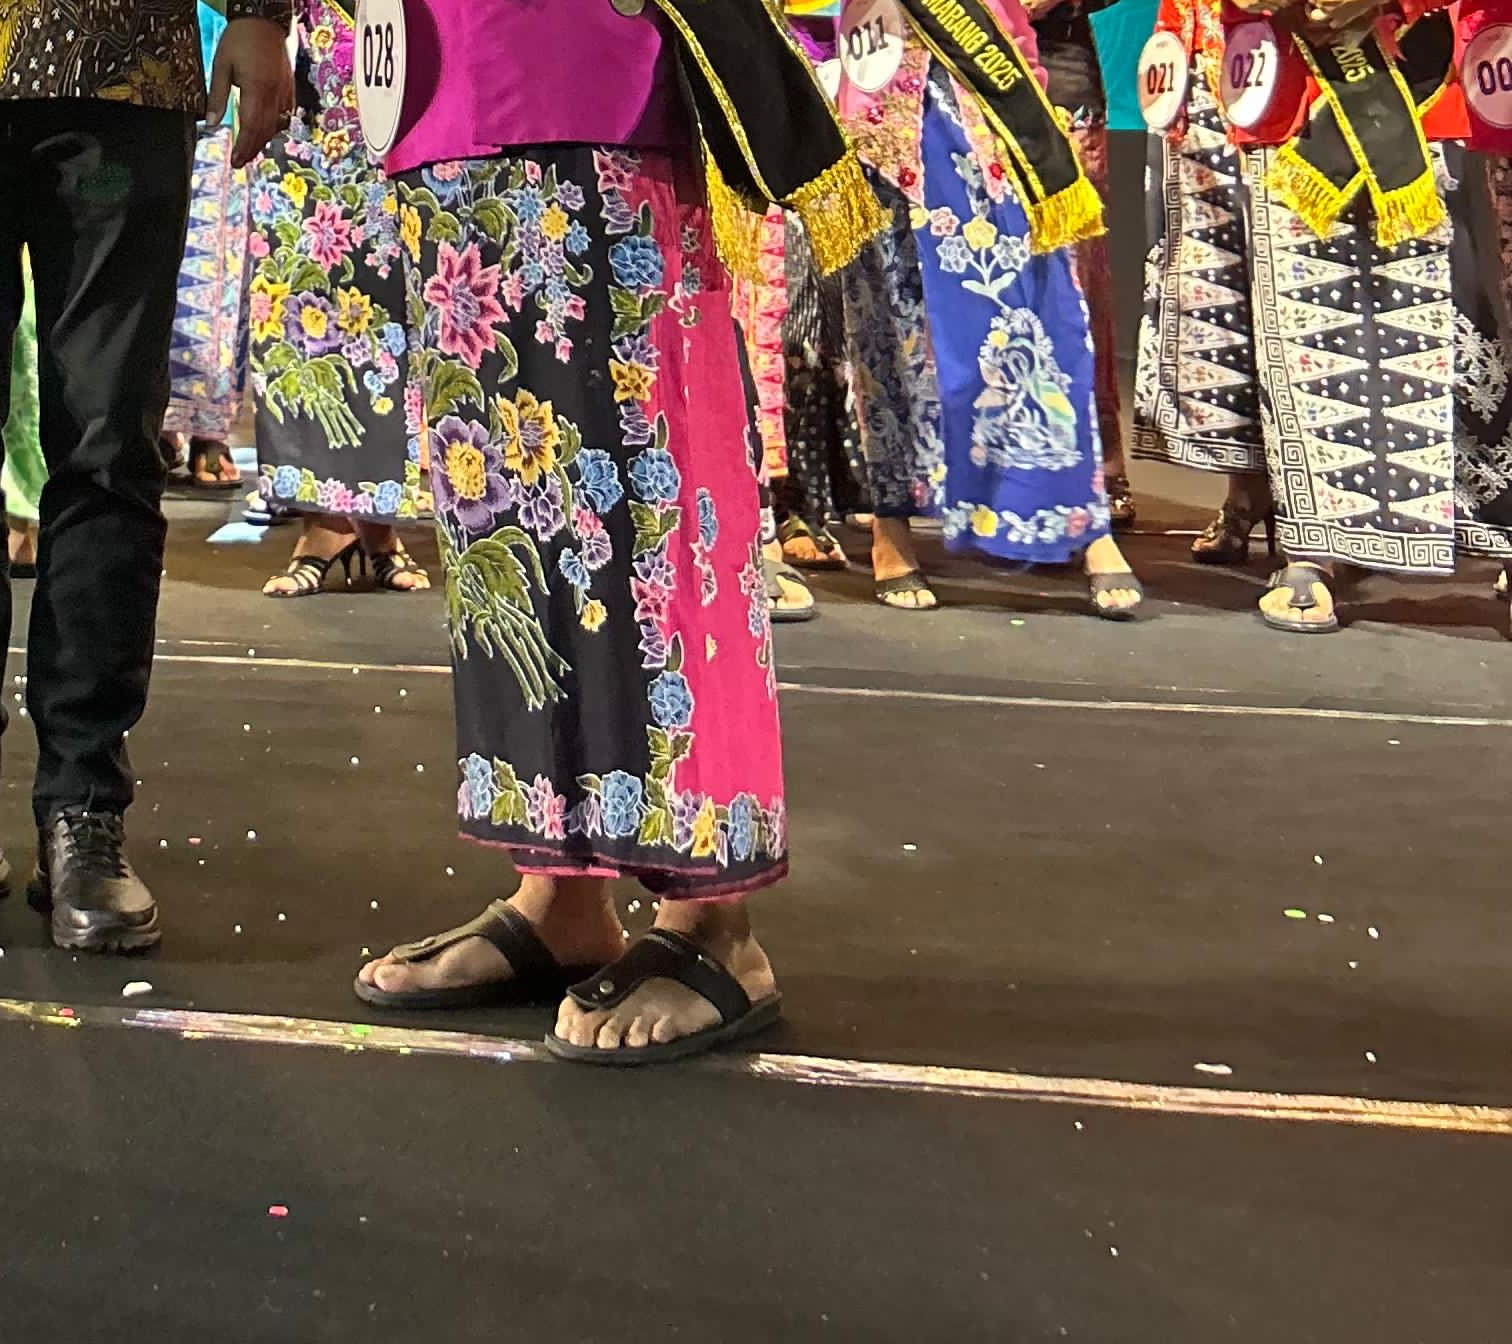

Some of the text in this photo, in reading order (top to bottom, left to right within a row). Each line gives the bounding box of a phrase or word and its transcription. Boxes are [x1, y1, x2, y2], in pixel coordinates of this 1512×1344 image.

[362, 23, 395, 89] 028
[849, 16, 889, 61] 011
[974, 43, 1023, 91] 2025
[1147, 62, 1175, 95] 021
[1231, 52, 1266, 89] 022
[1331, 45, 1375, 83] 2025
[1477, 57, 1512, 95] 00
